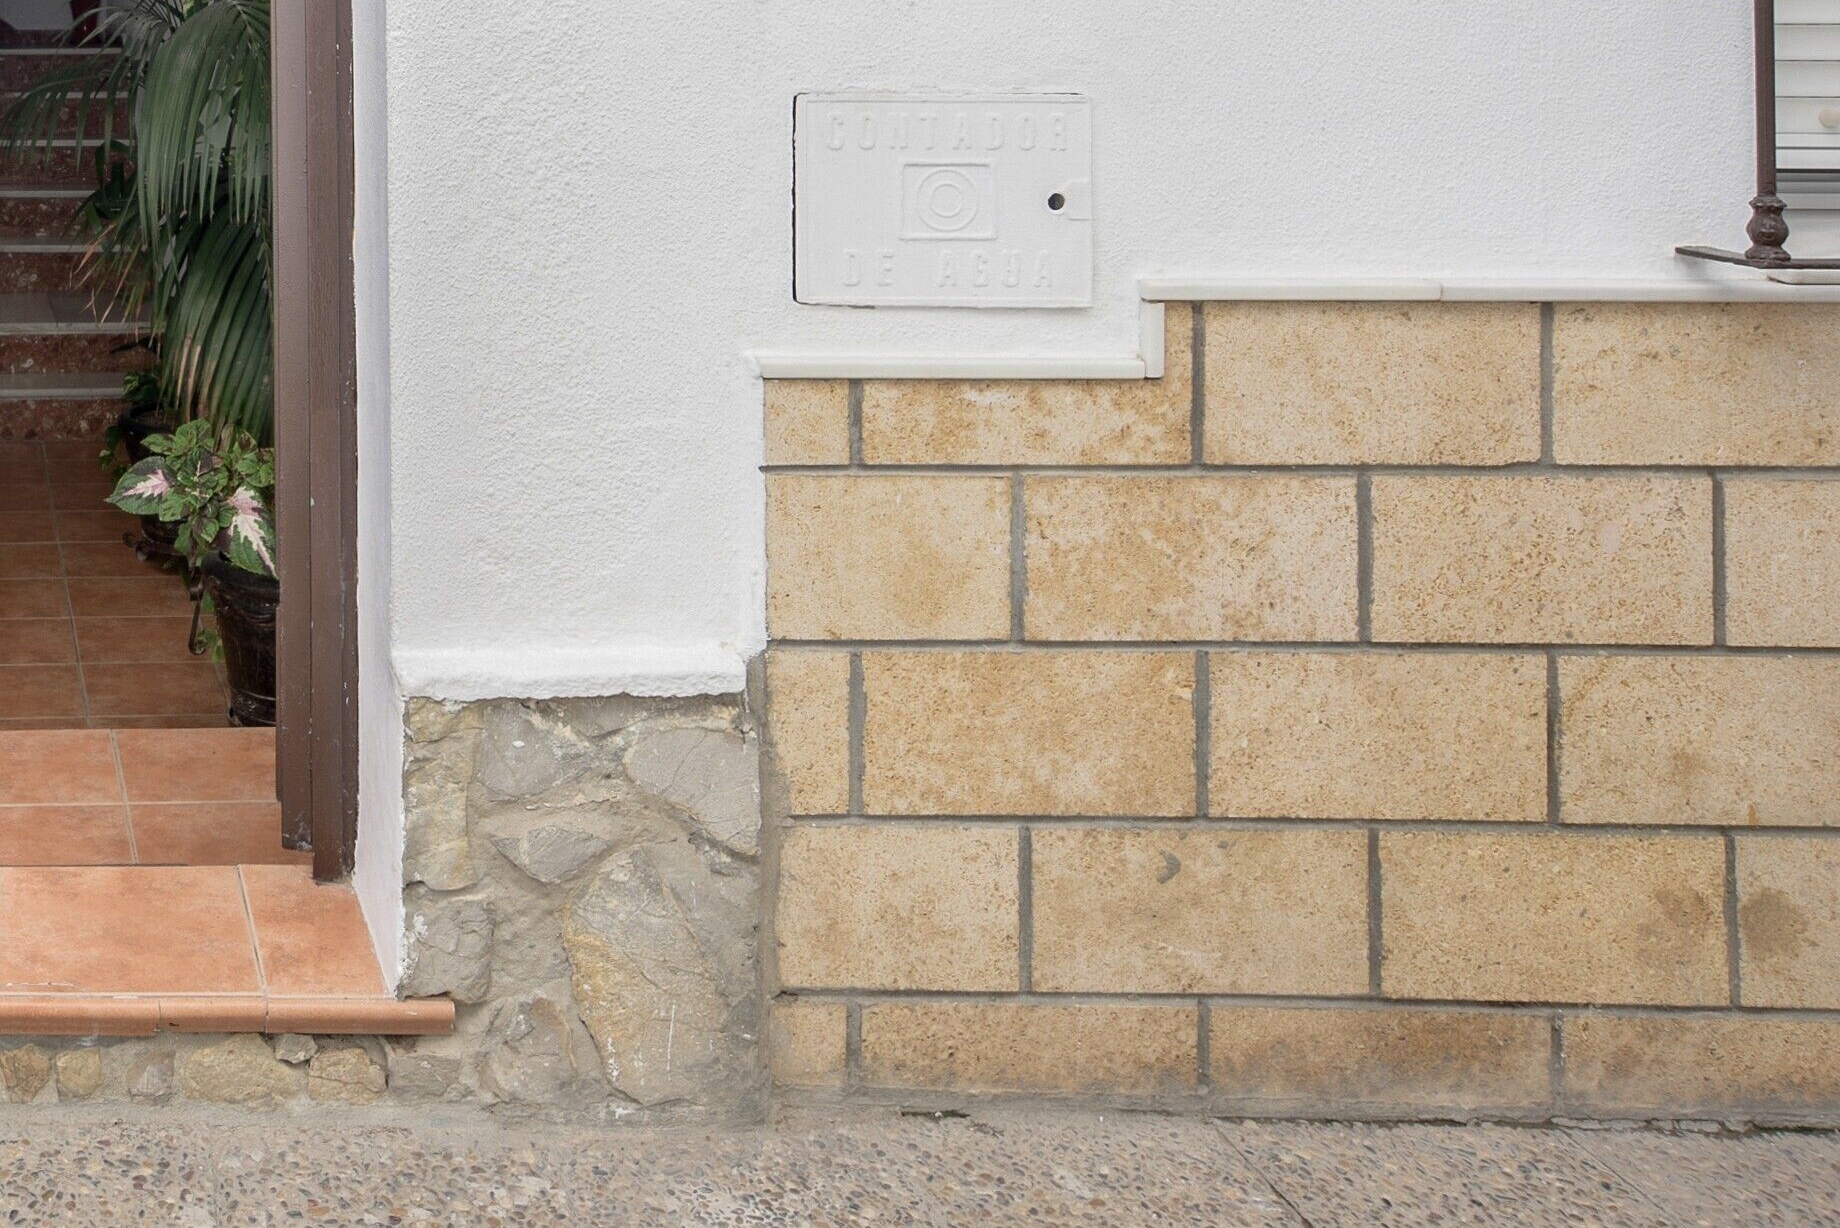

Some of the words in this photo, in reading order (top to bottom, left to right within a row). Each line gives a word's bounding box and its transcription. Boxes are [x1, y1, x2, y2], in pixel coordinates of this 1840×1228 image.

[826, 111, 1067, 151] CONTADOR
[841, 247, 896, 287] DE
[936, 247, 1054, 287] AGUA
